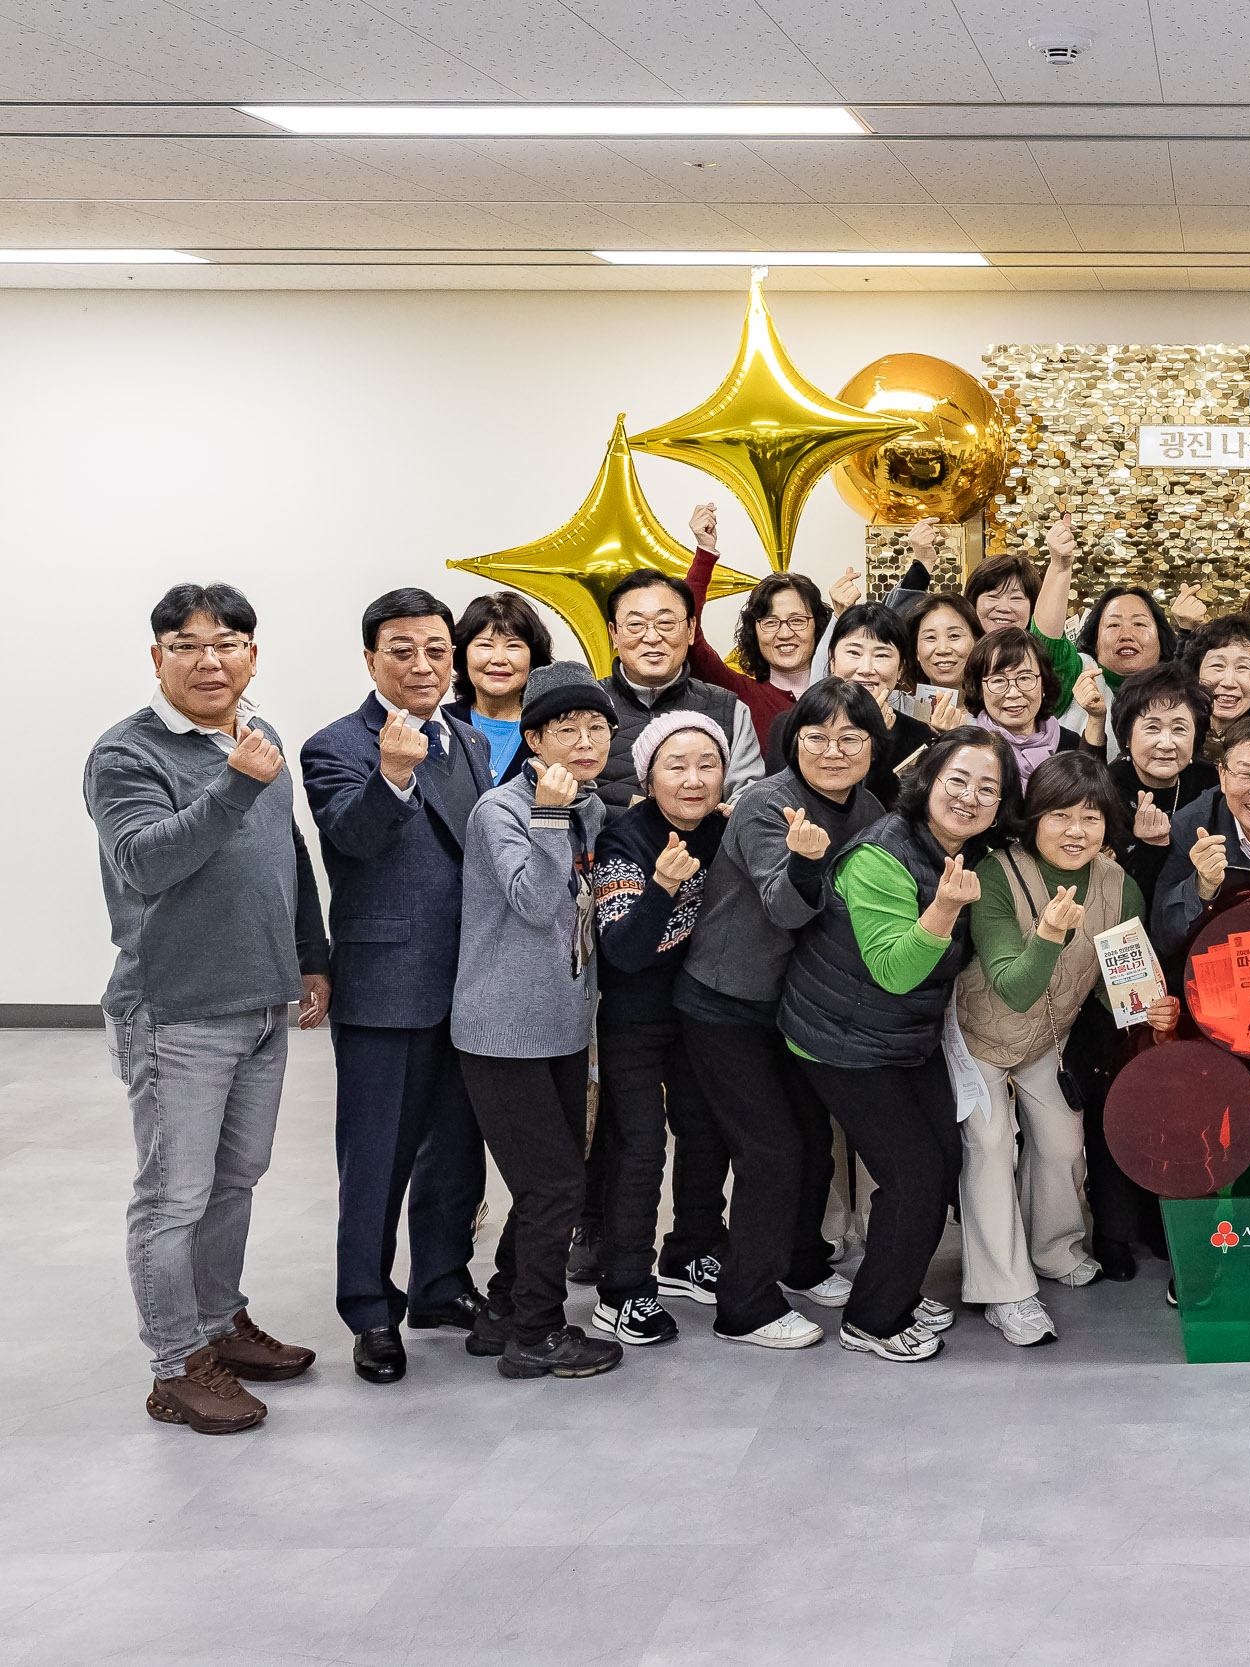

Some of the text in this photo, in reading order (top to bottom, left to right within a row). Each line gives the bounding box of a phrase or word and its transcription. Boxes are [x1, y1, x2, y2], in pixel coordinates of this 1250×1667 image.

[1159, 431, 1212, 459] 광진
[1104, 949, 1119, 957] 2026
[1105, 949, 1143, 968] 따뜻한
[1108, 960, 1145, 976] 겨울나기
